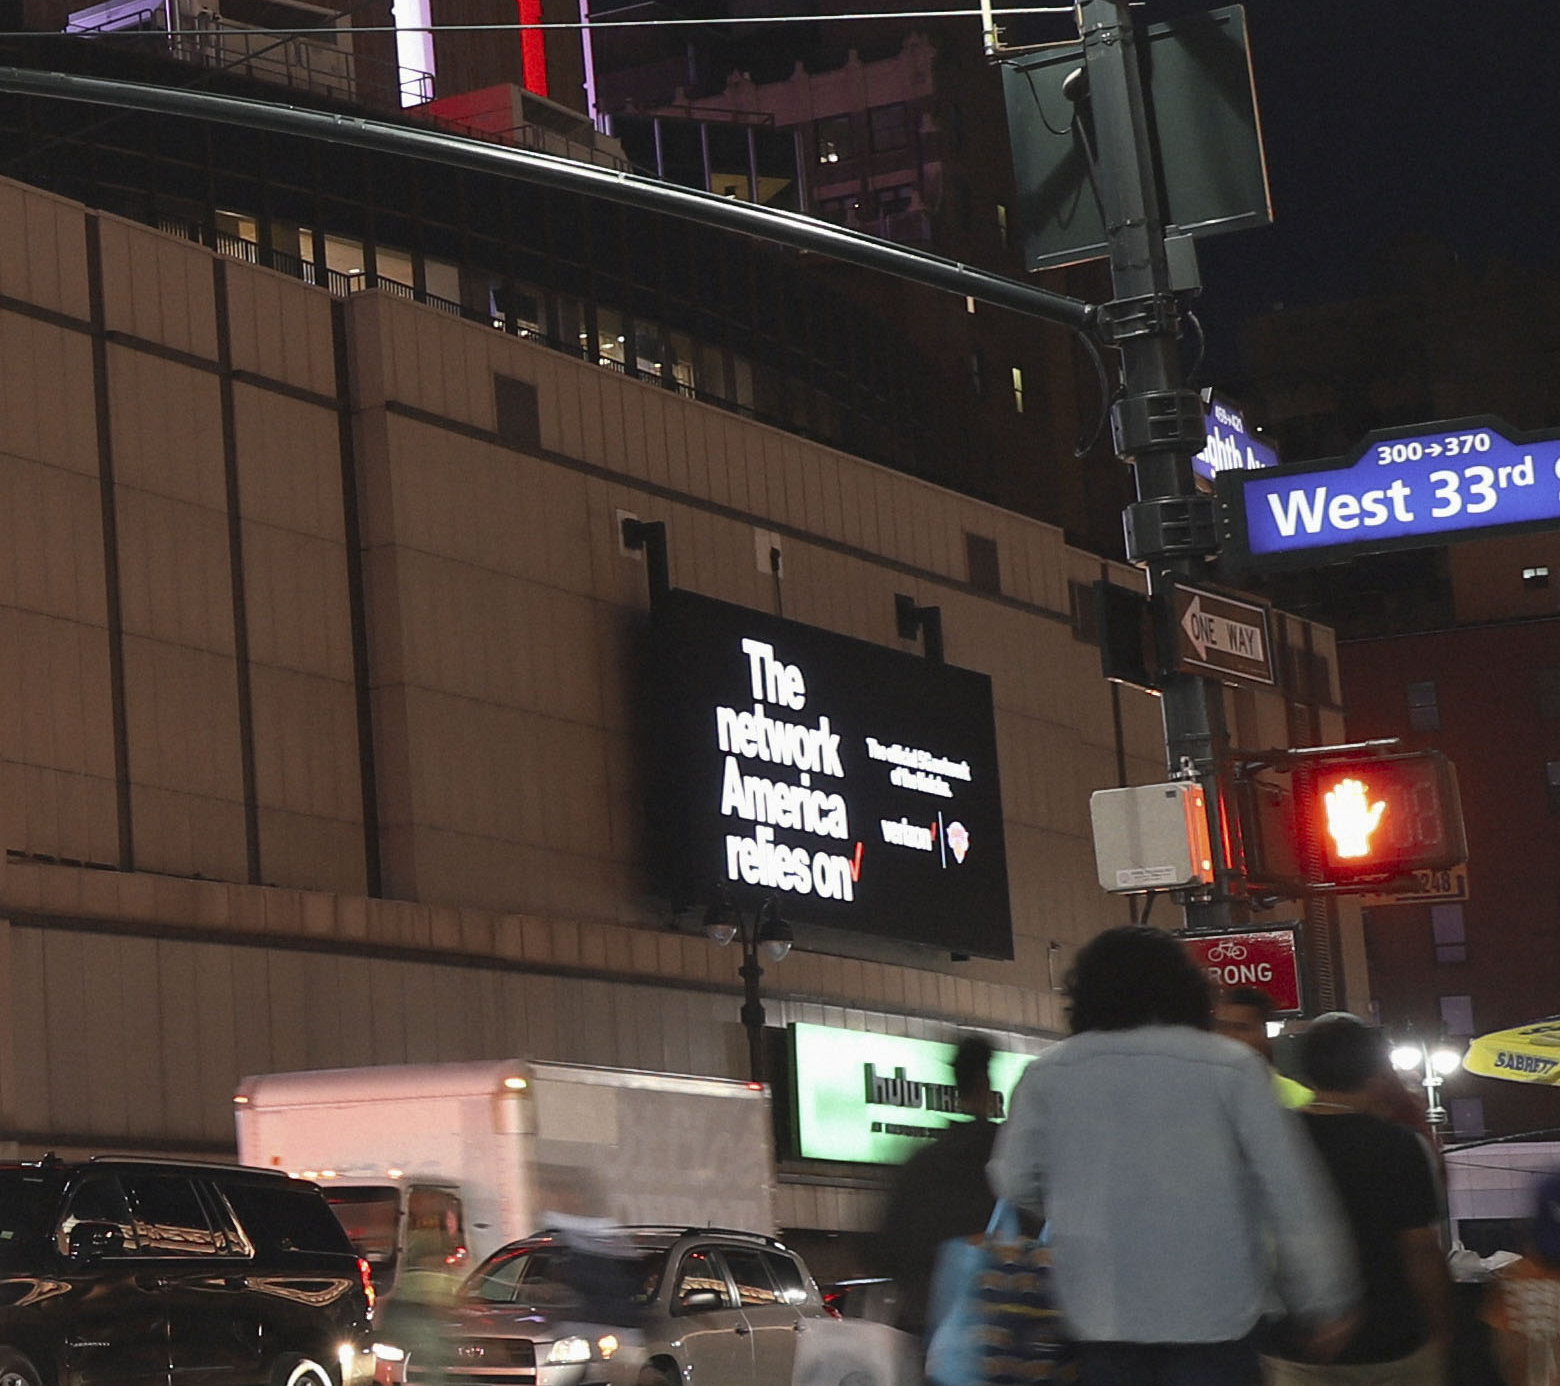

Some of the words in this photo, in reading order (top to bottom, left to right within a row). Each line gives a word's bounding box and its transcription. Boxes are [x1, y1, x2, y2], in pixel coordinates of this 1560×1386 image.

[1377, 442, 1422, 465] 300
[1444, 433, 1490, 456] 370
[1267, 480, 1414, 537] West
[1429, 456, 1535, 518] 33rd
[1190, 612, 1218, 647] ONE
[1227, 626, 1254, 657] WAY
[742, 638, 806, 710] The
[716, 703, 844, 777] network
[721, 755, 849, 839] America
[725, 825, 812, 893] relies
[812, 852, 854, 901] on
[1209, 963, 1272, 986] RONG
[864, 1063, 923, 1108] hulu
[925, 1083, 1006, 1119] THER
